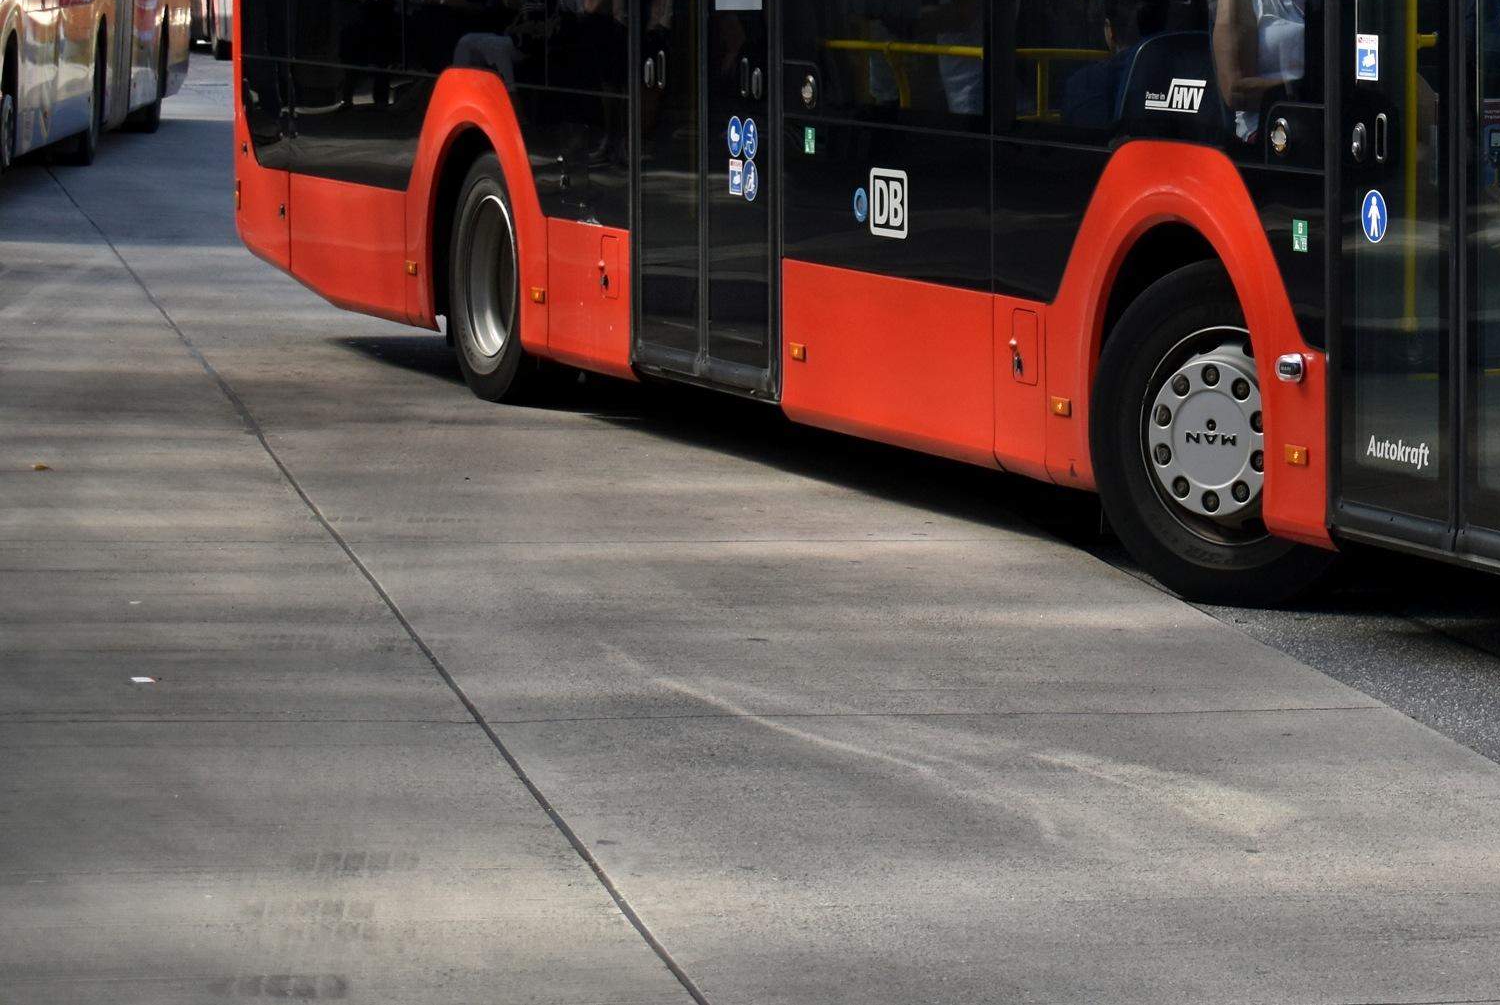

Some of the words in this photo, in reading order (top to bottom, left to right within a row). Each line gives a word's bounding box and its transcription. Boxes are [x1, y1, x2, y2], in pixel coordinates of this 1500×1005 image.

[1172, 86, 1205, 110] HVV
[873, 178, 905, 228] DB
[1185, 432, 1237, 447] MAN
[1366, 435, 1430, 470] Autokraft
